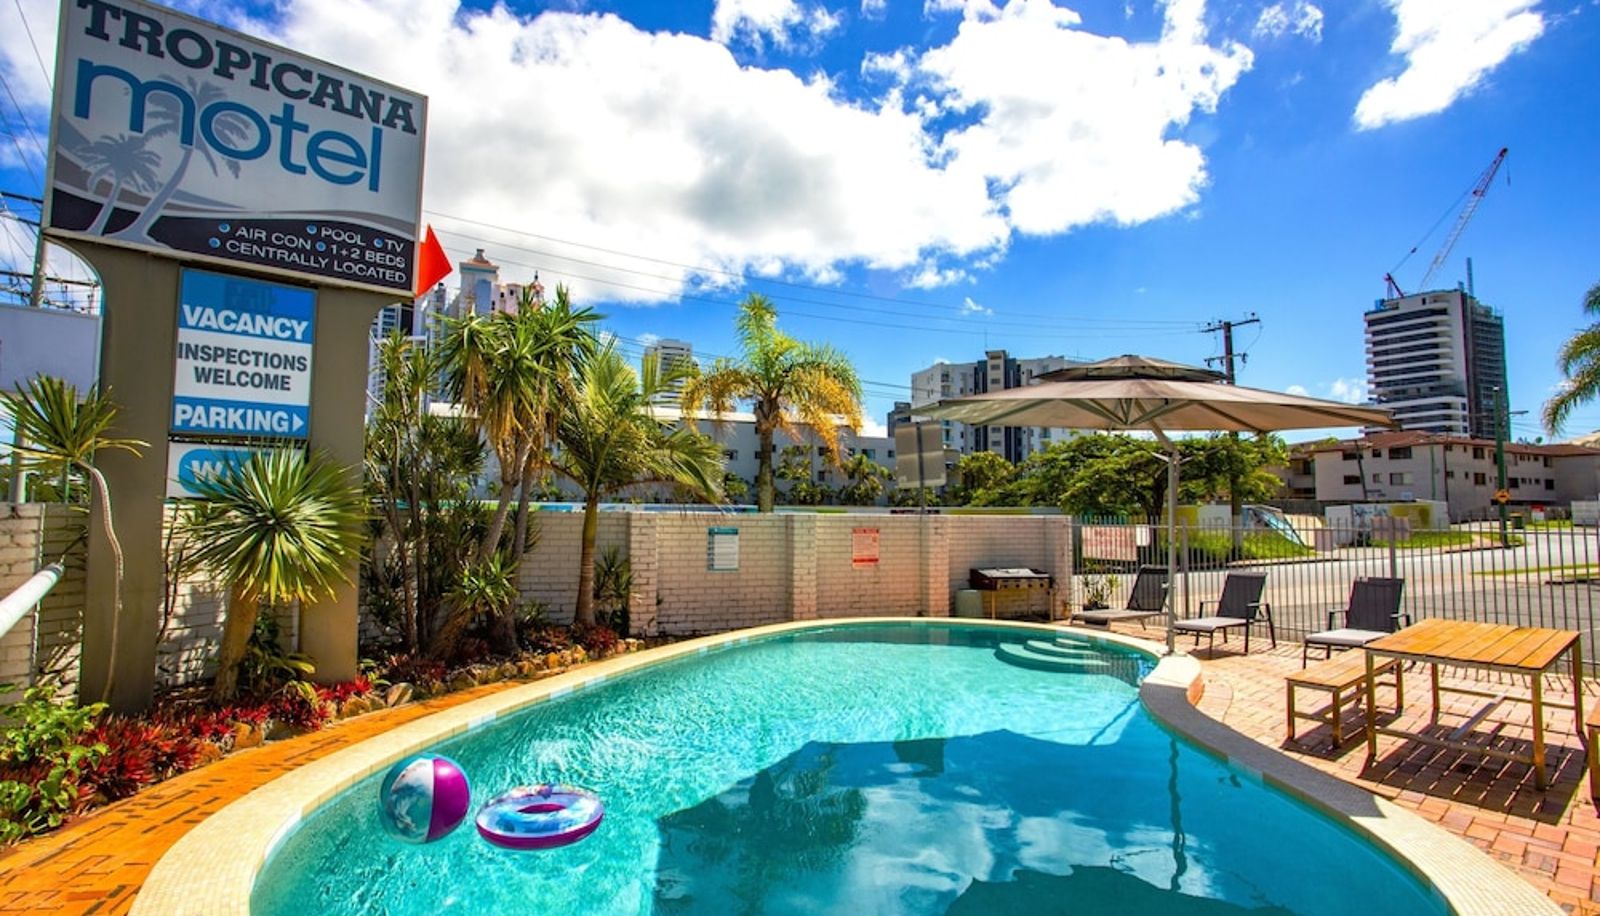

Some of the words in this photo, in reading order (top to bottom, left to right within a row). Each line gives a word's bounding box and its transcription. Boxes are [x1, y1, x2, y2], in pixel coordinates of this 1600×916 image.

[76, 0, 417, 135] TROPICANA
[74, 58, 383, 193] motel
[235, 226, 267, 242] AIR
[271, 232, 311, 250] CON
[365, 250, 406, 269] BEDS
[321, 227, 366, 246] POOL
[385, 239, 405, 252] TV
[226, 239, 329, 269] CENTRALLY
[333, 260, 407, 284] LOCATED
[182, 304, 309, 340] VACANCY
[178, 342, 308, 372] INSPECTIONS
[194, 366, 292, 391] WELCOME
[174, 403, 289, 432] PARKING
